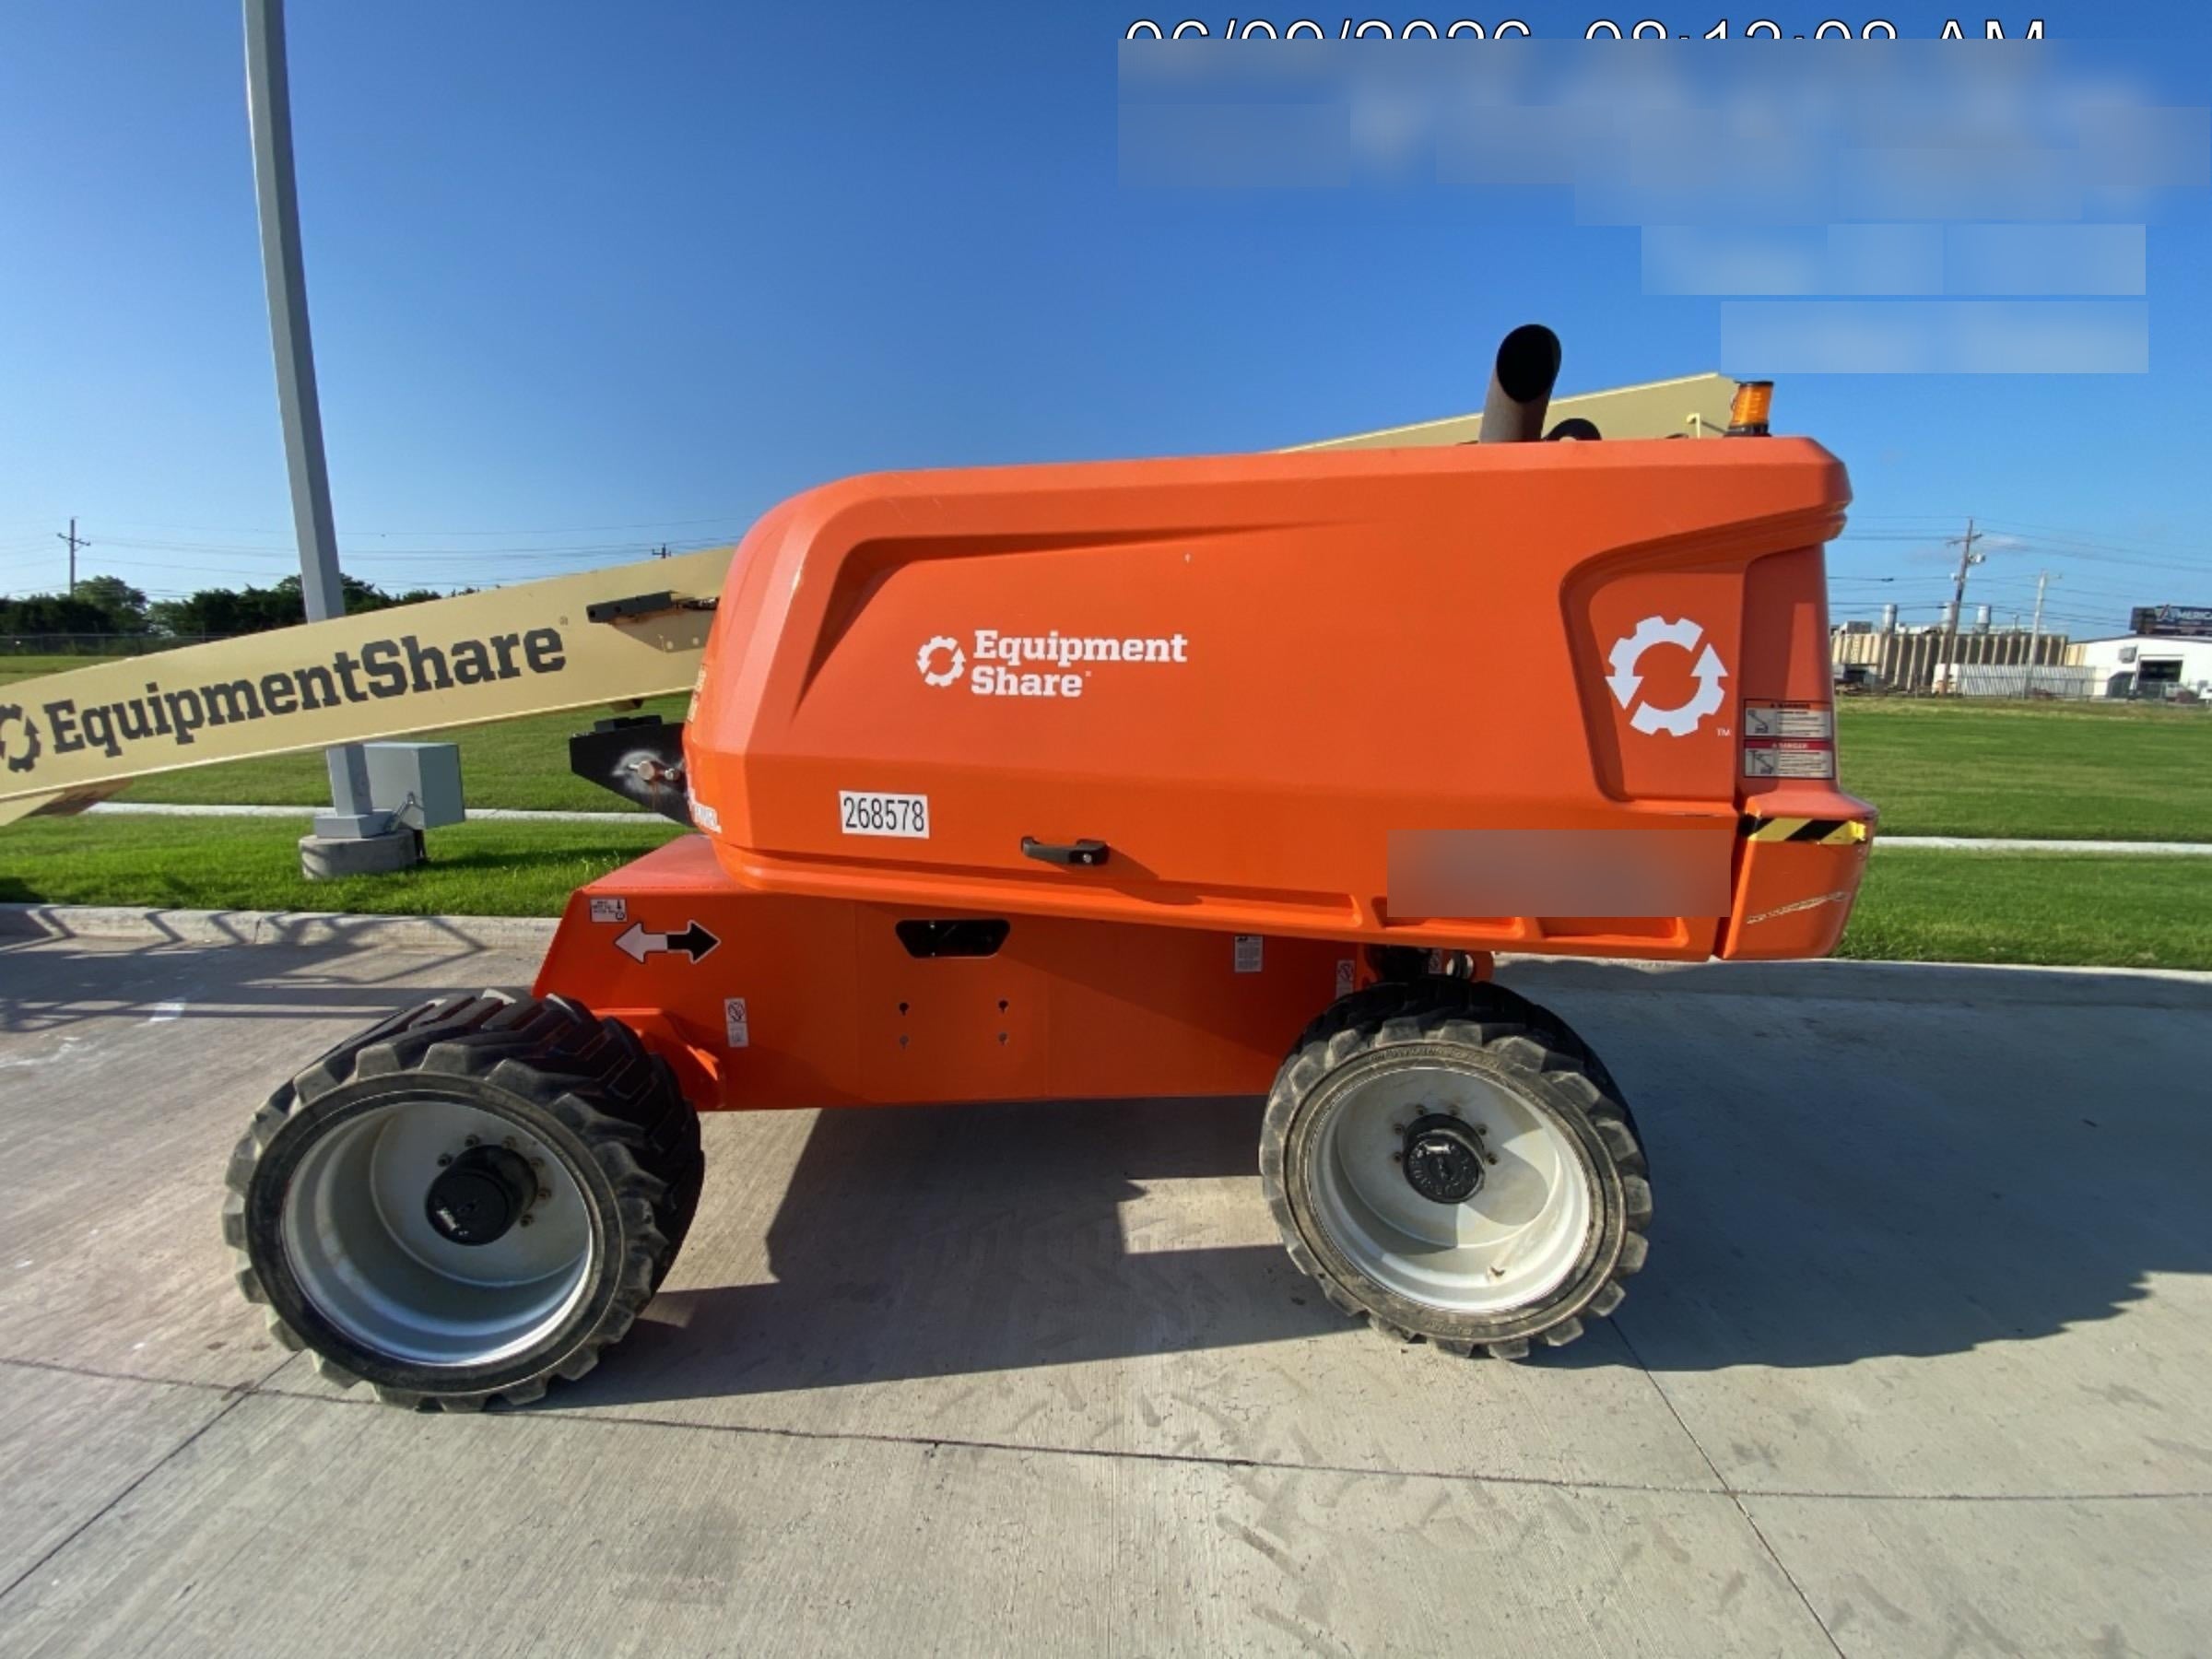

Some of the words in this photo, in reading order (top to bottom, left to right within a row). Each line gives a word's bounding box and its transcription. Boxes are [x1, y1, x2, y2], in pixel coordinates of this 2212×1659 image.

[973, 629, 1188, 667] Equipment
[42, 628, 566, 758] EquipmentShare
[971, 665, 1083, 698] Share
[843, 796, 924, 832] 268578
